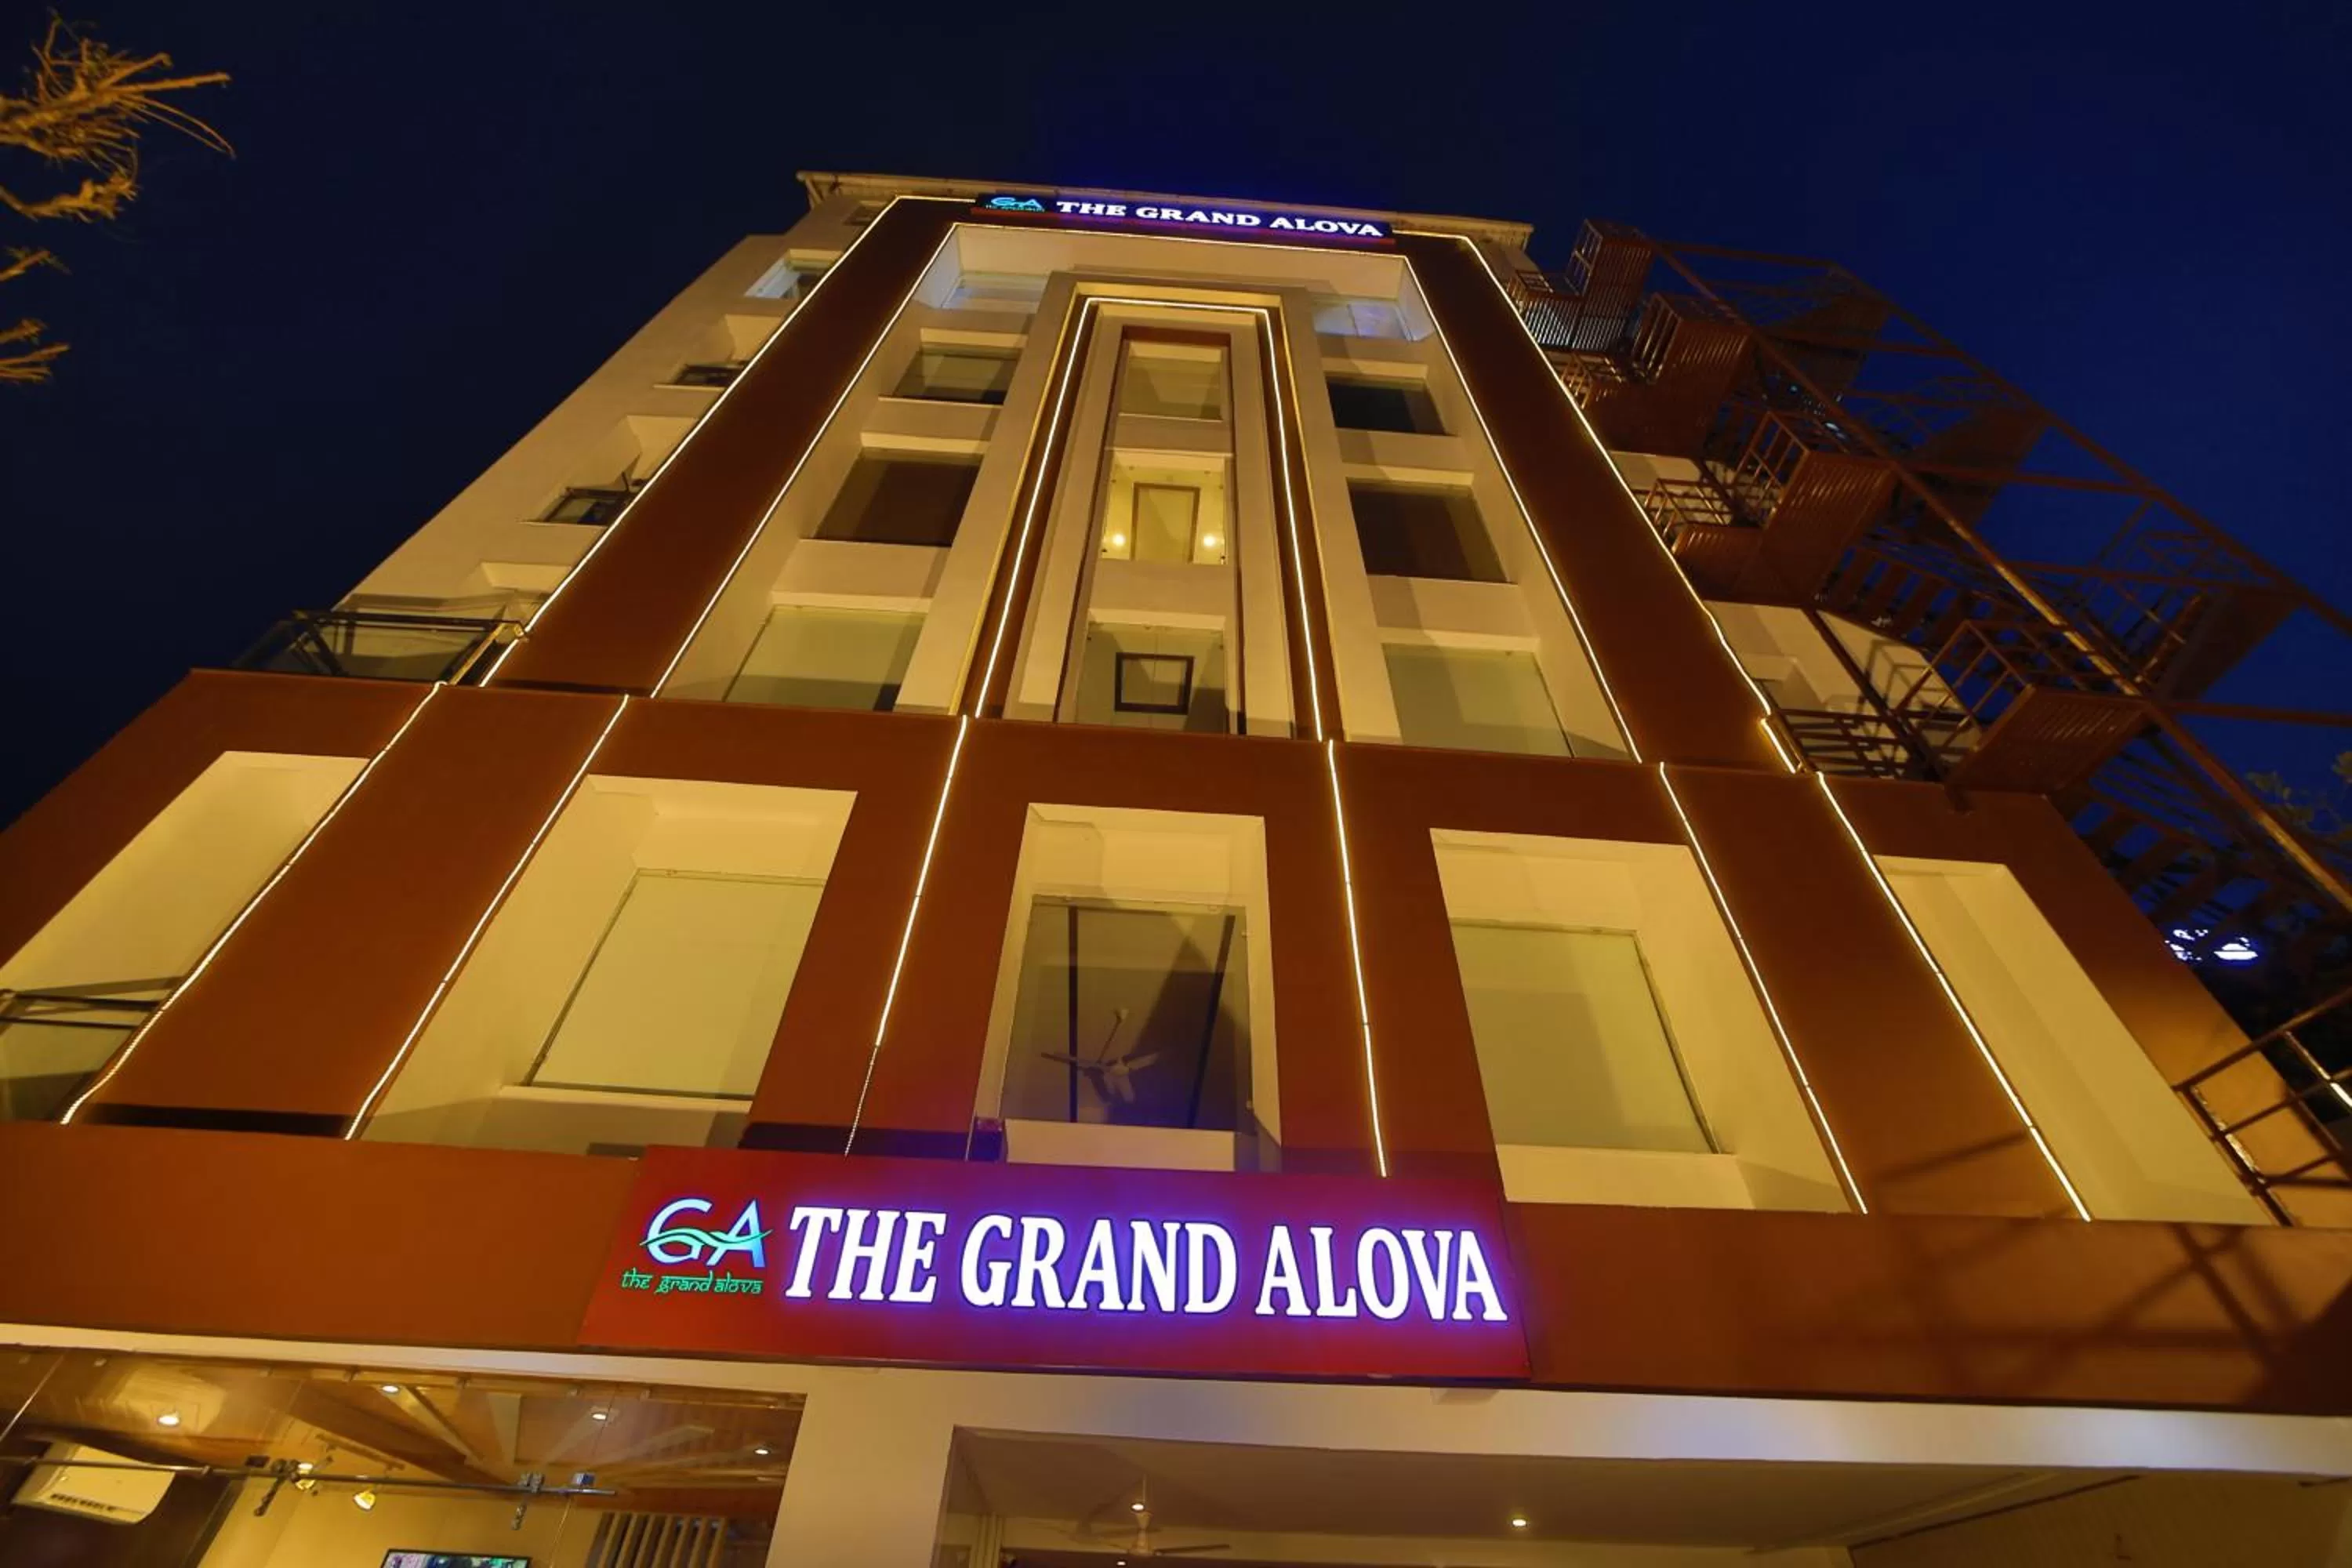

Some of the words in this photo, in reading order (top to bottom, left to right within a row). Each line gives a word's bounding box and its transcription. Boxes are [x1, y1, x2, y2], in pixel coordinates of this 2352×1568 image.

[1056, 201, 1127, 216] THE
[1135, 206, 1261, 227] GRAND
[1269, 216, 1384, 237] ALOVA
[643, 1198, 767, 1269] GA
[621, 1266, 653, 1290] the
[654, 1269, 714, 1294] grand
[713, 1271, 764, 1294] alova
[785, 1206, 947, 1304] THE
[960, 1213, 1237, 1315] GRAND
[1254, 1225, 1508, 1321] ALOVA
